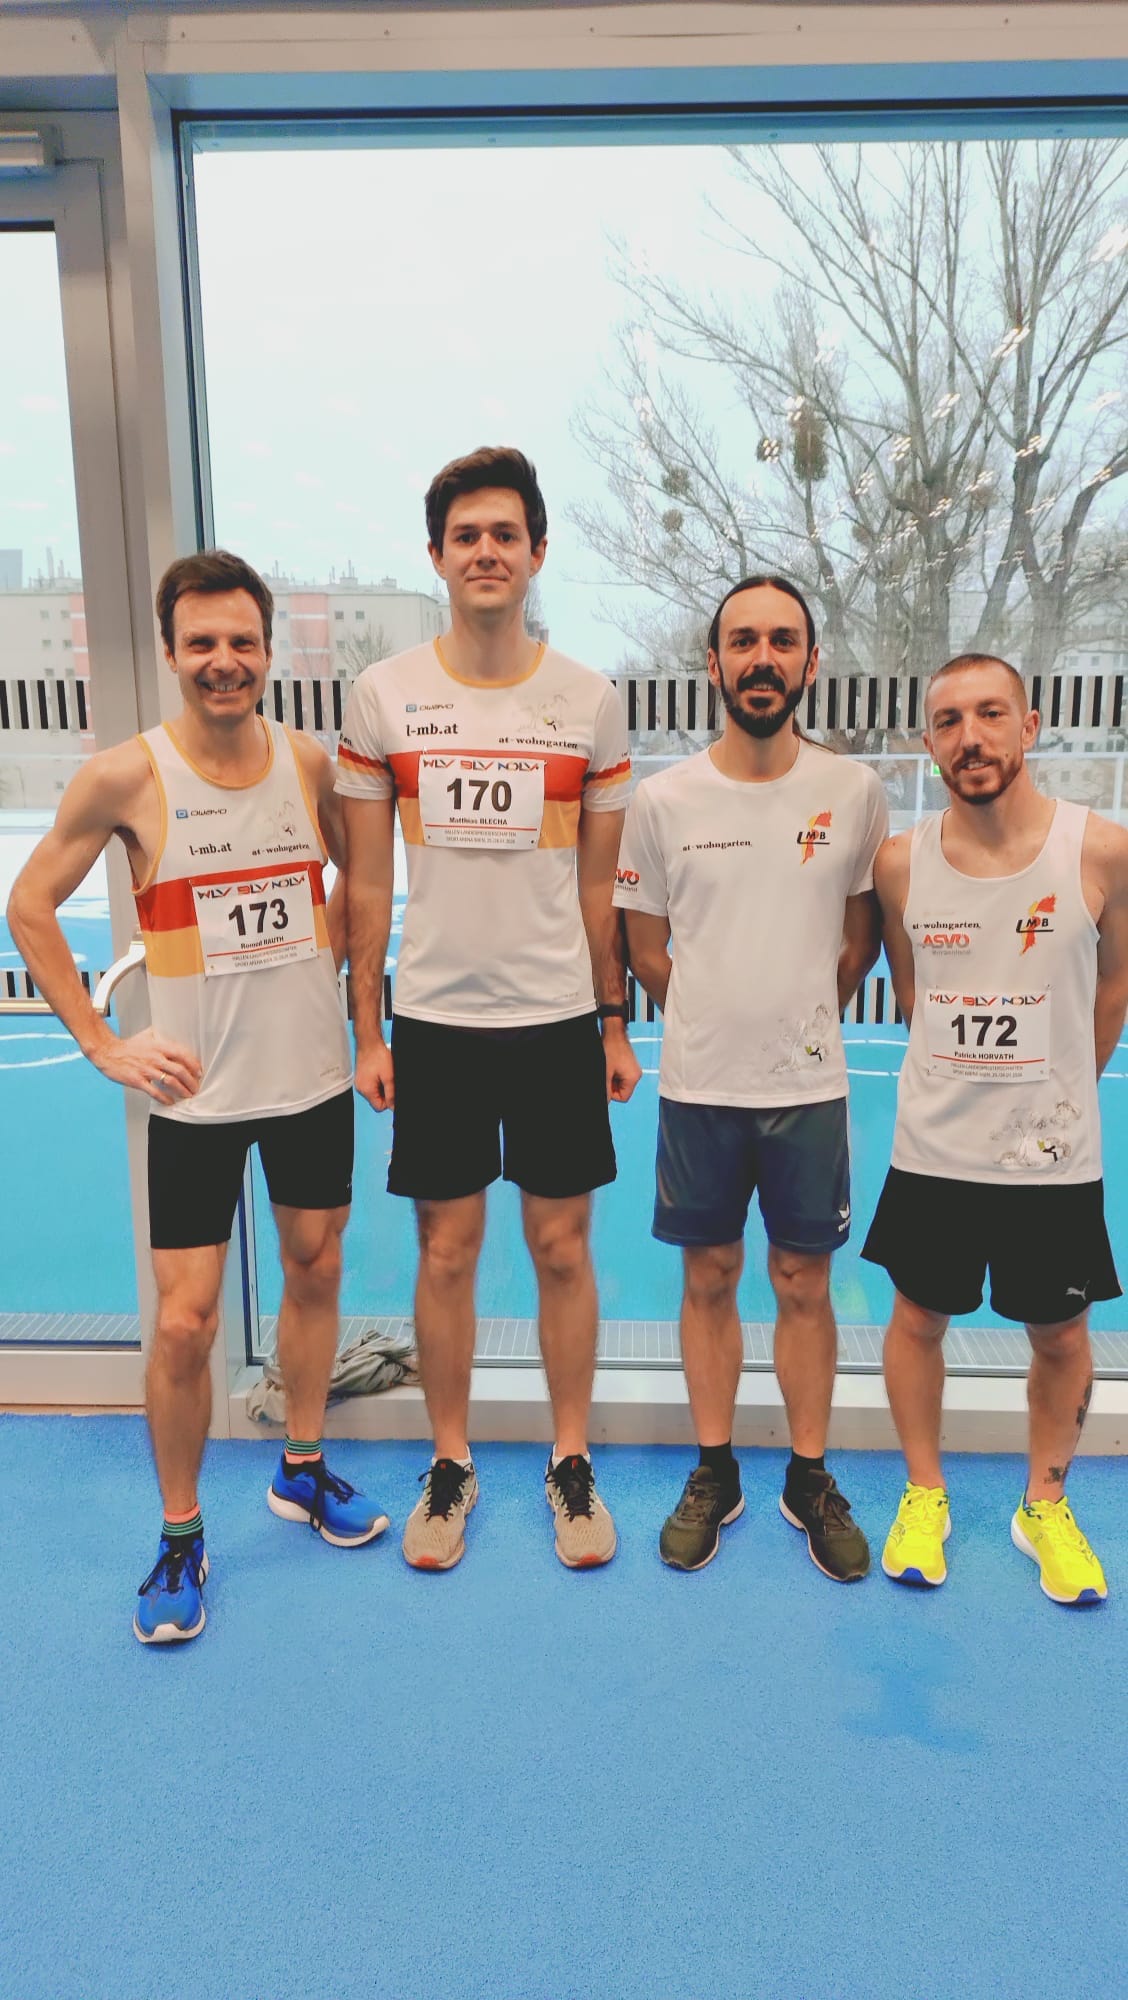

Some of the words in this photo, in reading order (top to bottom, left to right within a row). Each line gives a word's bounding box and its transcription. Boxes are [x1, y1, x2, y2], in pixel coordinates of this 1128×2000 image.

[406, 723, 458, 737] l-mb.at
[447, 778, 512, 812] 170
[449, 817, 478, 825] Matthias
[480, 817, 508, 826] BLECHA
[189, 842, 232, 856] l-mb.at
[228, 898, 289, 936] 173
[951, 1014, 1018, 1046] 172
[954, 1051, 977, 1059] Patrick
[978, 1052, 1014, 1060] HORVATH
